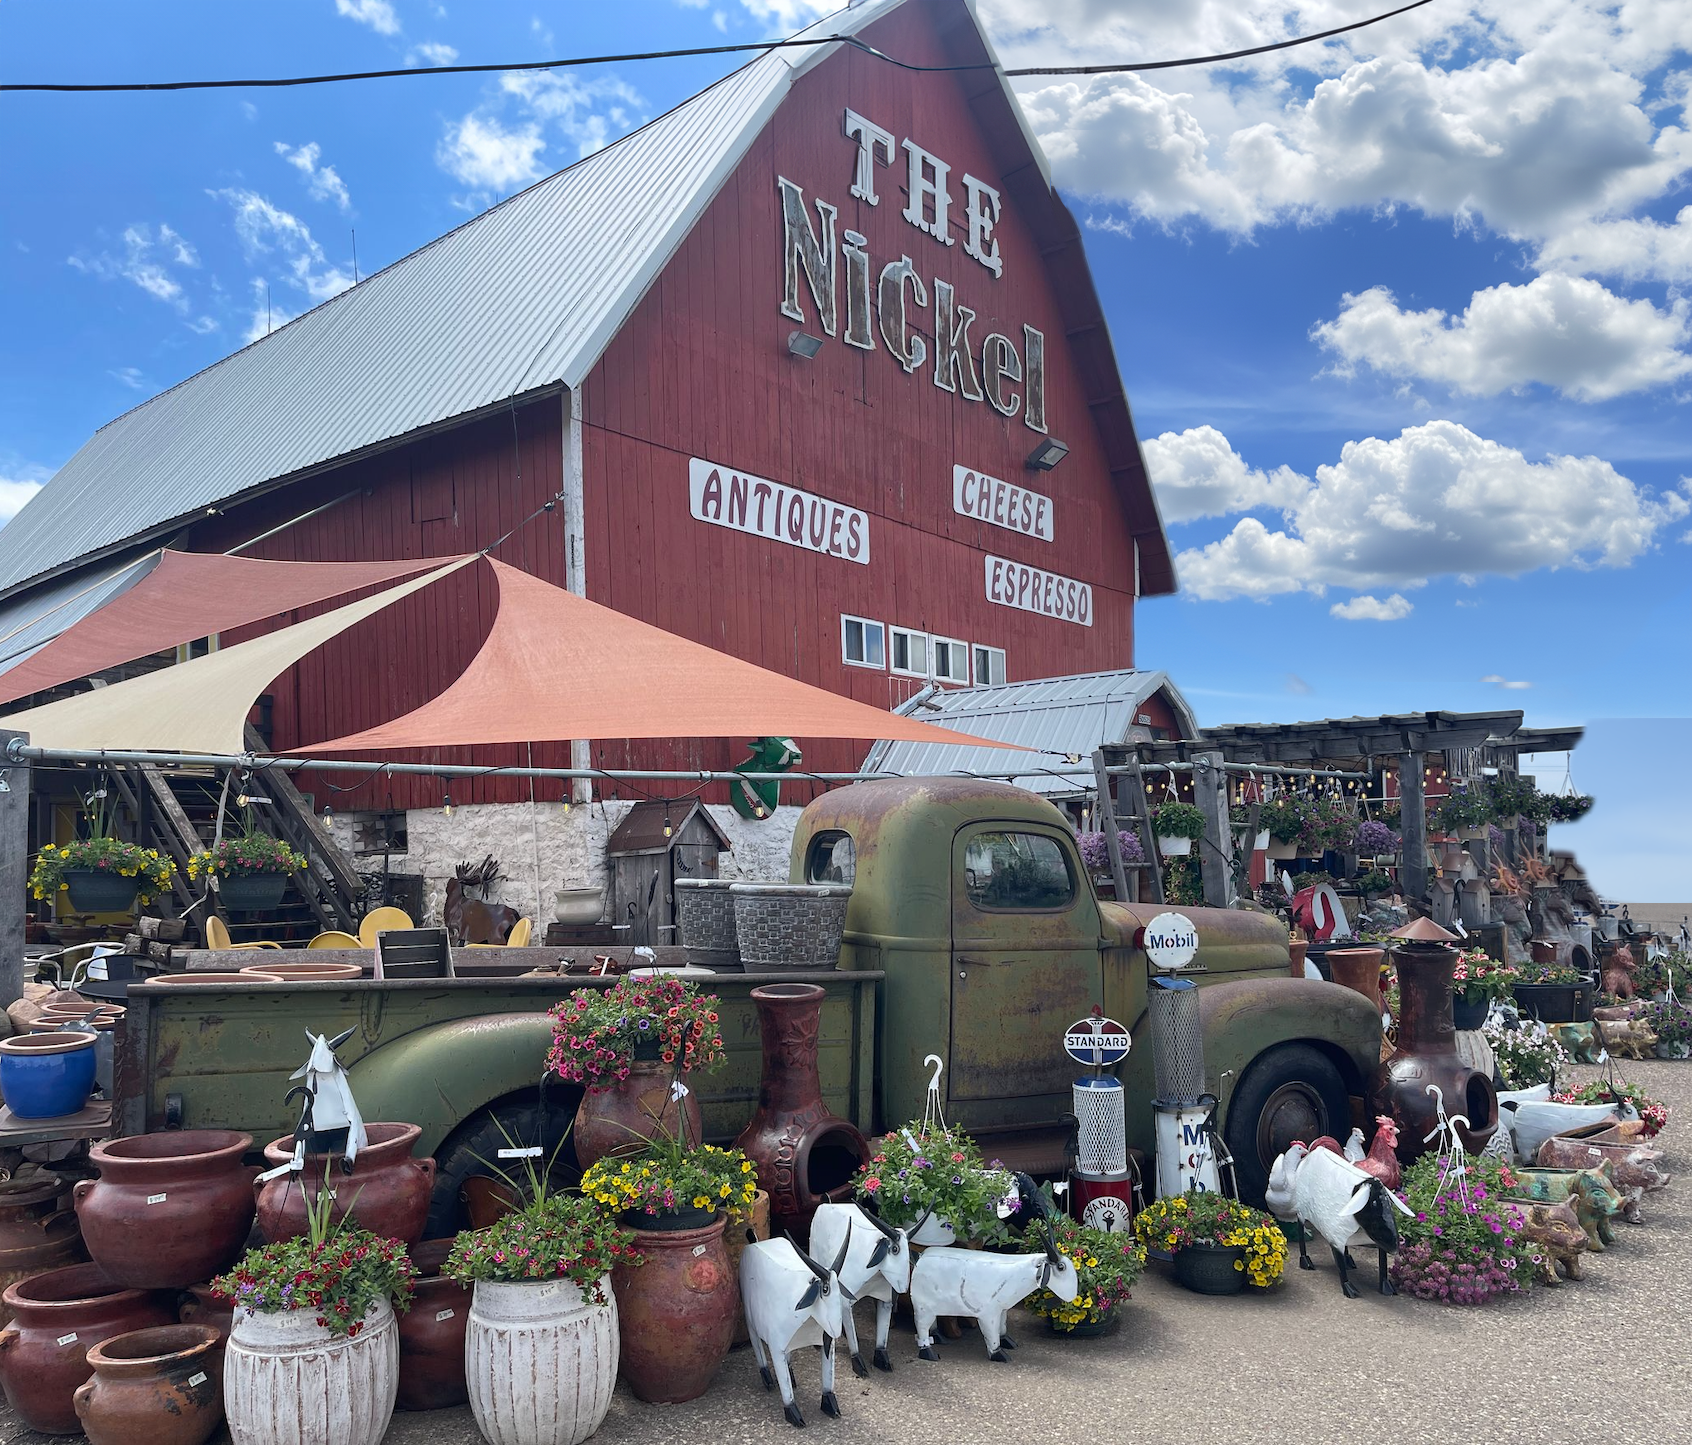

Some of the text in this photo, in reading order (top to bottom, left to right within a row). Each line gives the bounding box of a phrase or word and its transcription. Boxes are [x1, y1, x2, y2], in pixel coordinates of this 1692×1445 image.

[845, 107, 1002, 279] THE
[702, 469, 861, 558] ANTIQUES
[961, 472, 1046, 536] CHEESE
[991, 560, 1088, 622] ESPRESSO
[1150, 933, 1194, 949] Mobil
[1067, 1036, 1128, 1047] STANDARD
